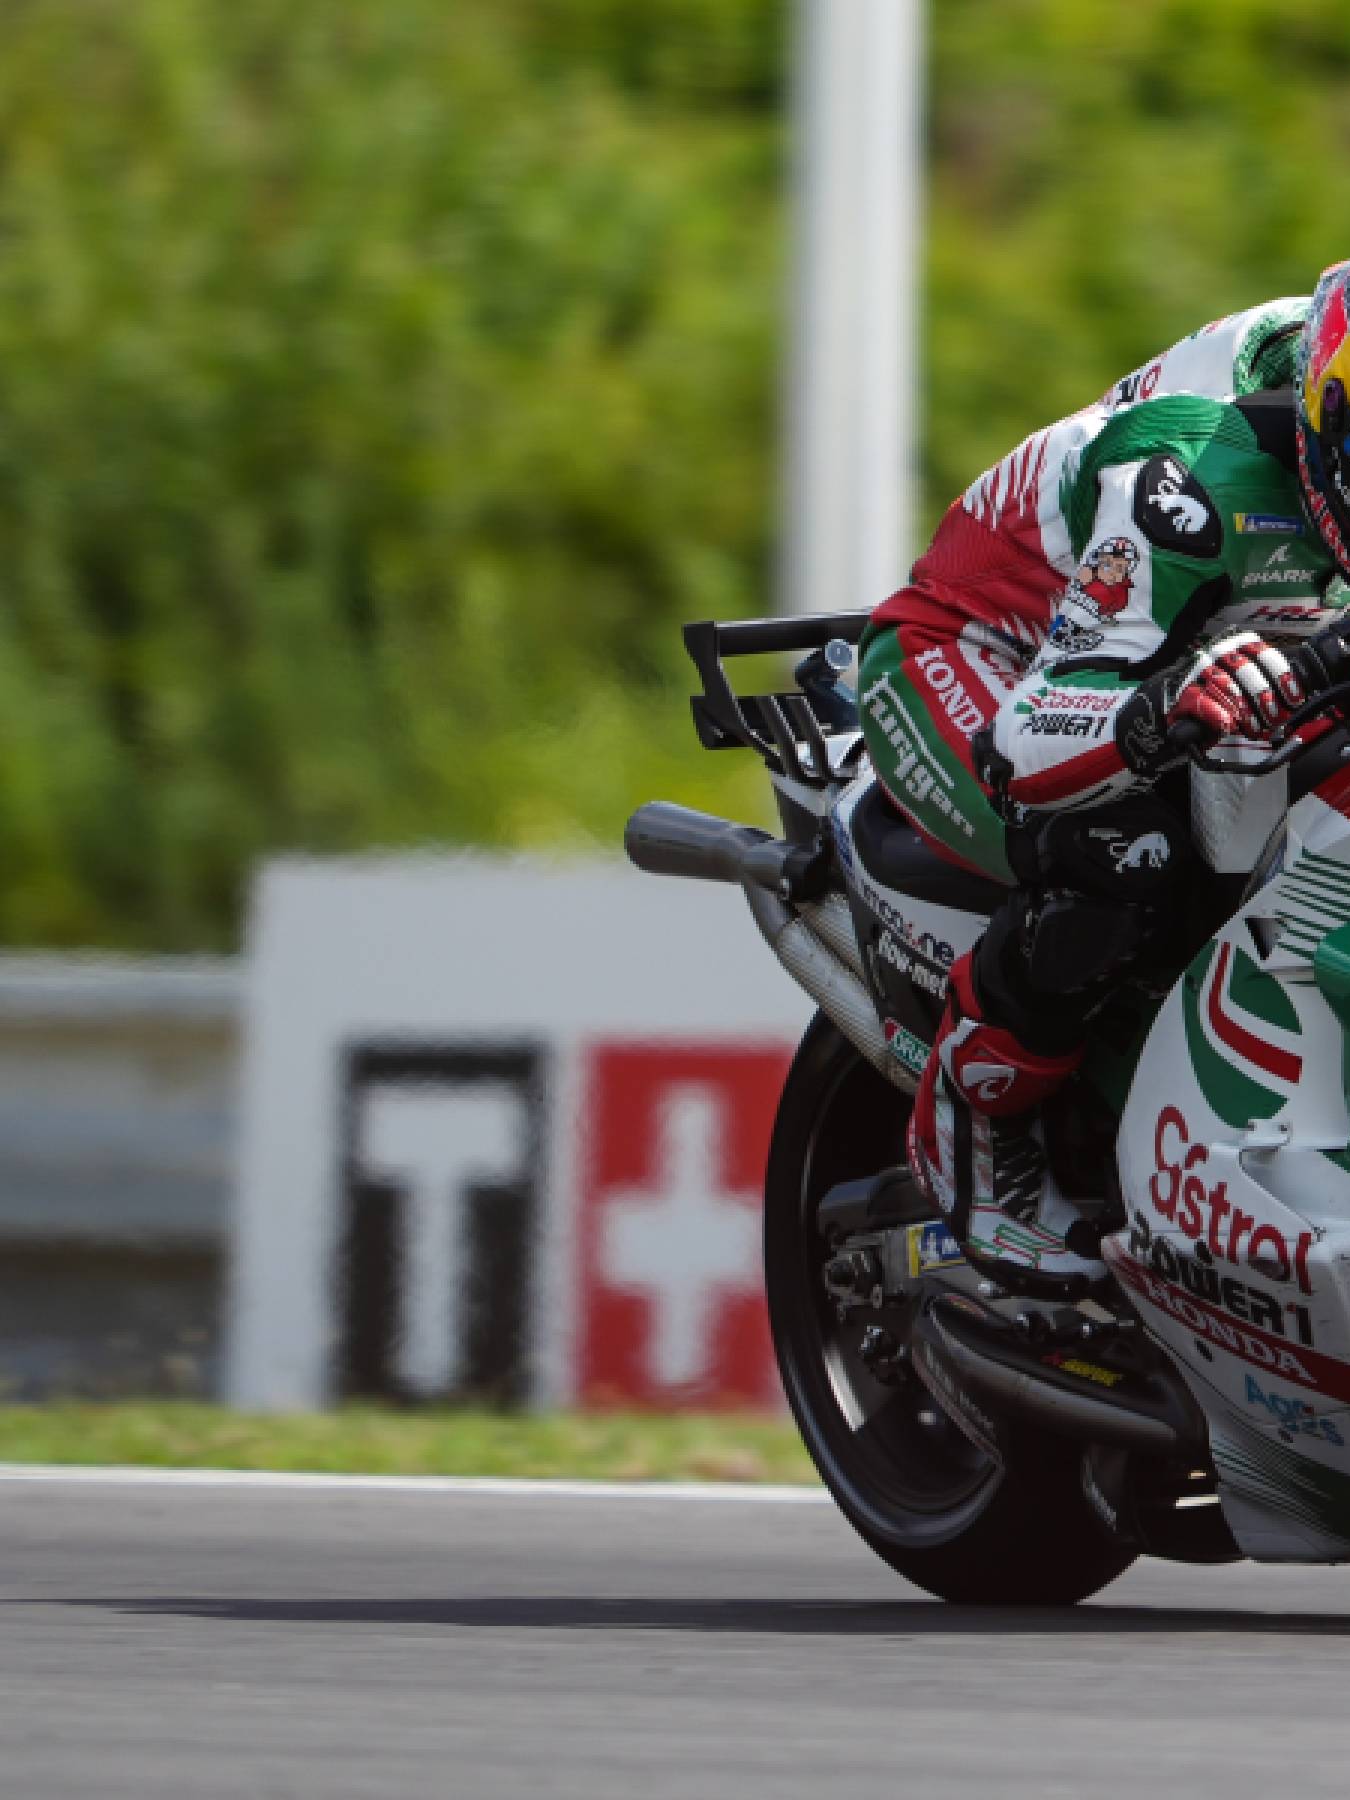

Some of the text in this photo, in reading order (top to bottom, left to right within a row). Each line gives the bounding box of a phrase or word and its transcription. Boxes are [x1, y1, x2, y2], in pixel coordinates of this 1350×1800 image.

[1242, 569, 1317, 590] SHARK
[914, 648, 985, 741] OND
[879, 930, 949, 1000] flow-met
[1149, 1104, 1313, 1297] Castrol
[1129, 1208, 1313, 1348] POWER1
[1143, 1278, 1318, 1385] HONDA
